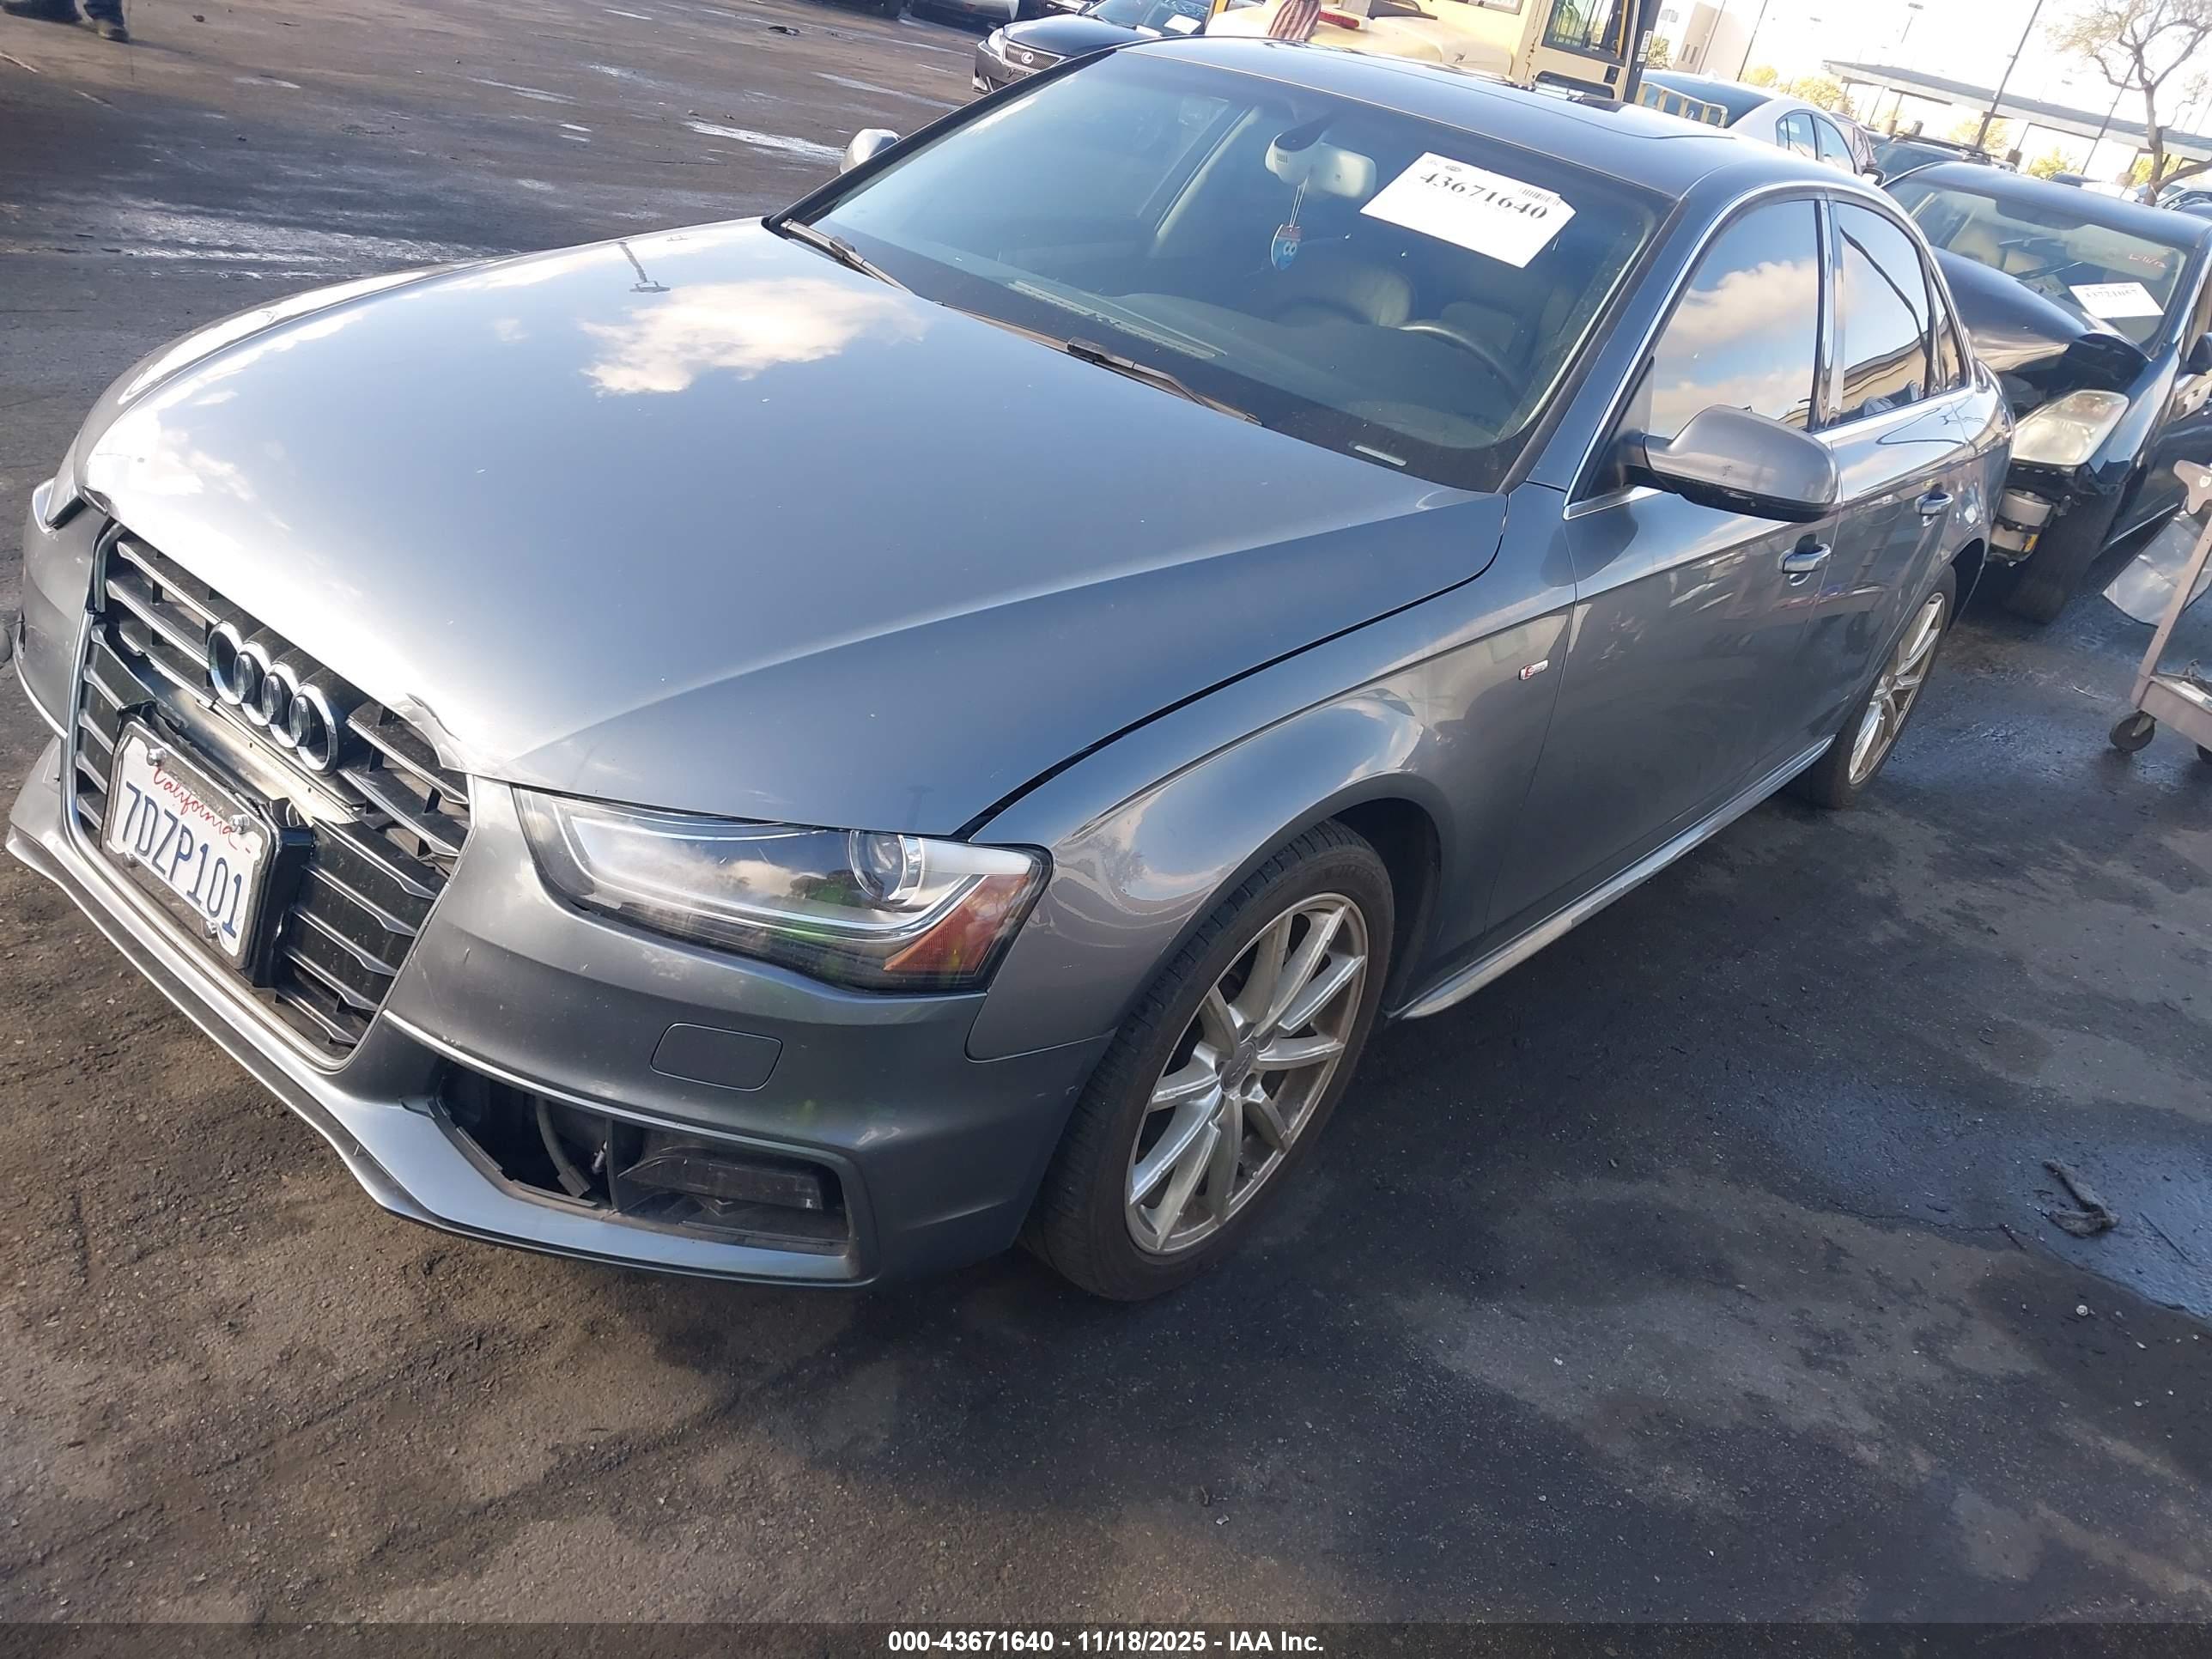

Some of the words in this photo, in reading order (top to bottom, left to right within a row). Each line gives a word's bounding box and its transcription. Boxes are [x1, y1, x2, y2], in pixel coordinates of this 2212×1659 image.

[1419, 172, 1548, 219] 43671640
[153, 761, 239, 851] California
[123, 781, 243, 939] 7DZP101
